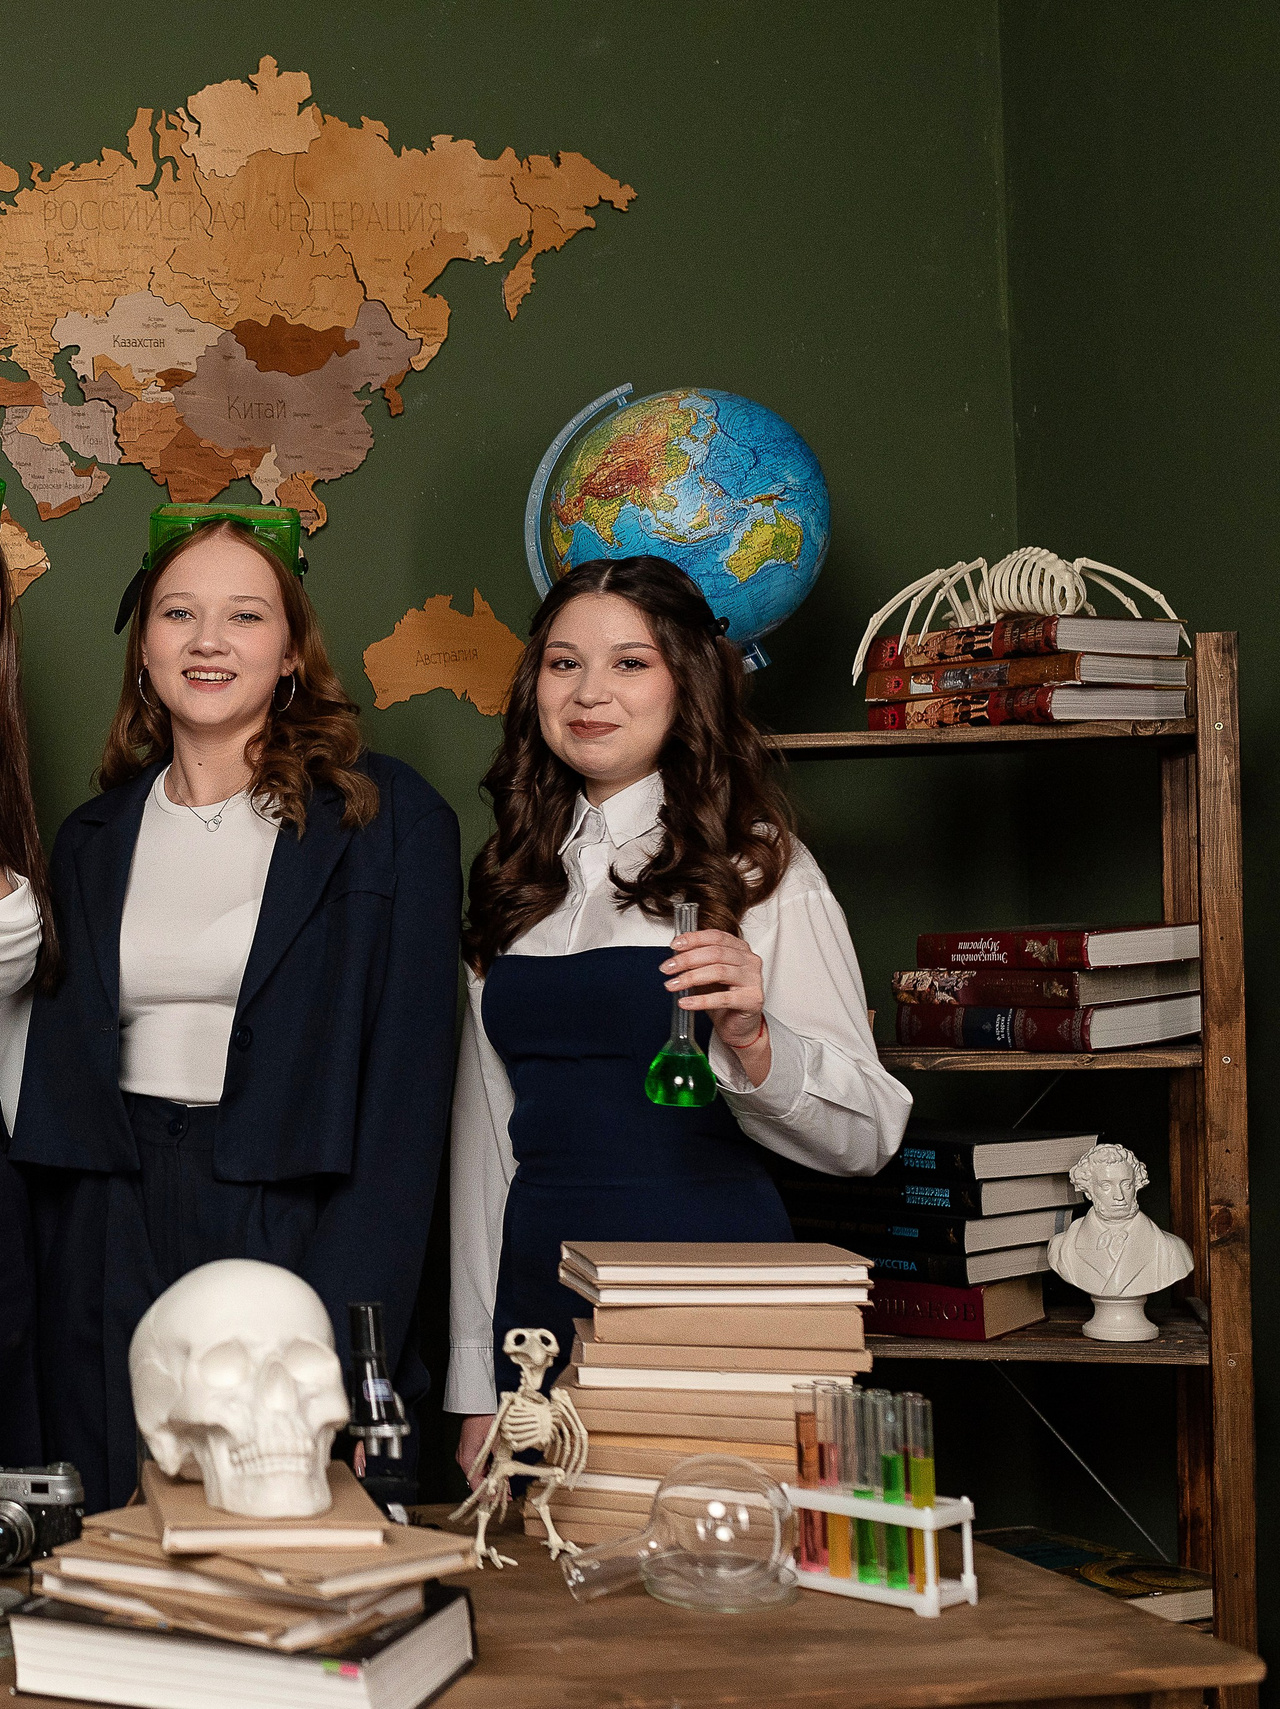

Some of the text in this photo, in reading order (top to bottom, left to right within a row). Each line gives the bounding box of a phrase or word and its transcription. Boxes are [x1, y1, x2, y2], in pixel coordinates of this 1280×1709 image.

[43, 199, 442, 235] РОССИЙСКАЯ ФЕДЕРАЦИЯ
[112, 335, 165, 348] Казахстан
[227, 396, 286, 419] Китай
[415, 649, 478, 667] Австралия
[958, 938, 1000, 952] Мудрости
[951, 951, 1008, 965] Энциклопедия
[904, 1148, 936, 1160] ИСТОРИЯ
[904, 1158, 936, 1169] РОССИИ
[905, 1185, 950, 1198] ВСЕМИРНАЯ
[906, 1195, 951, 1208] ЛИТЕРАТУРА
